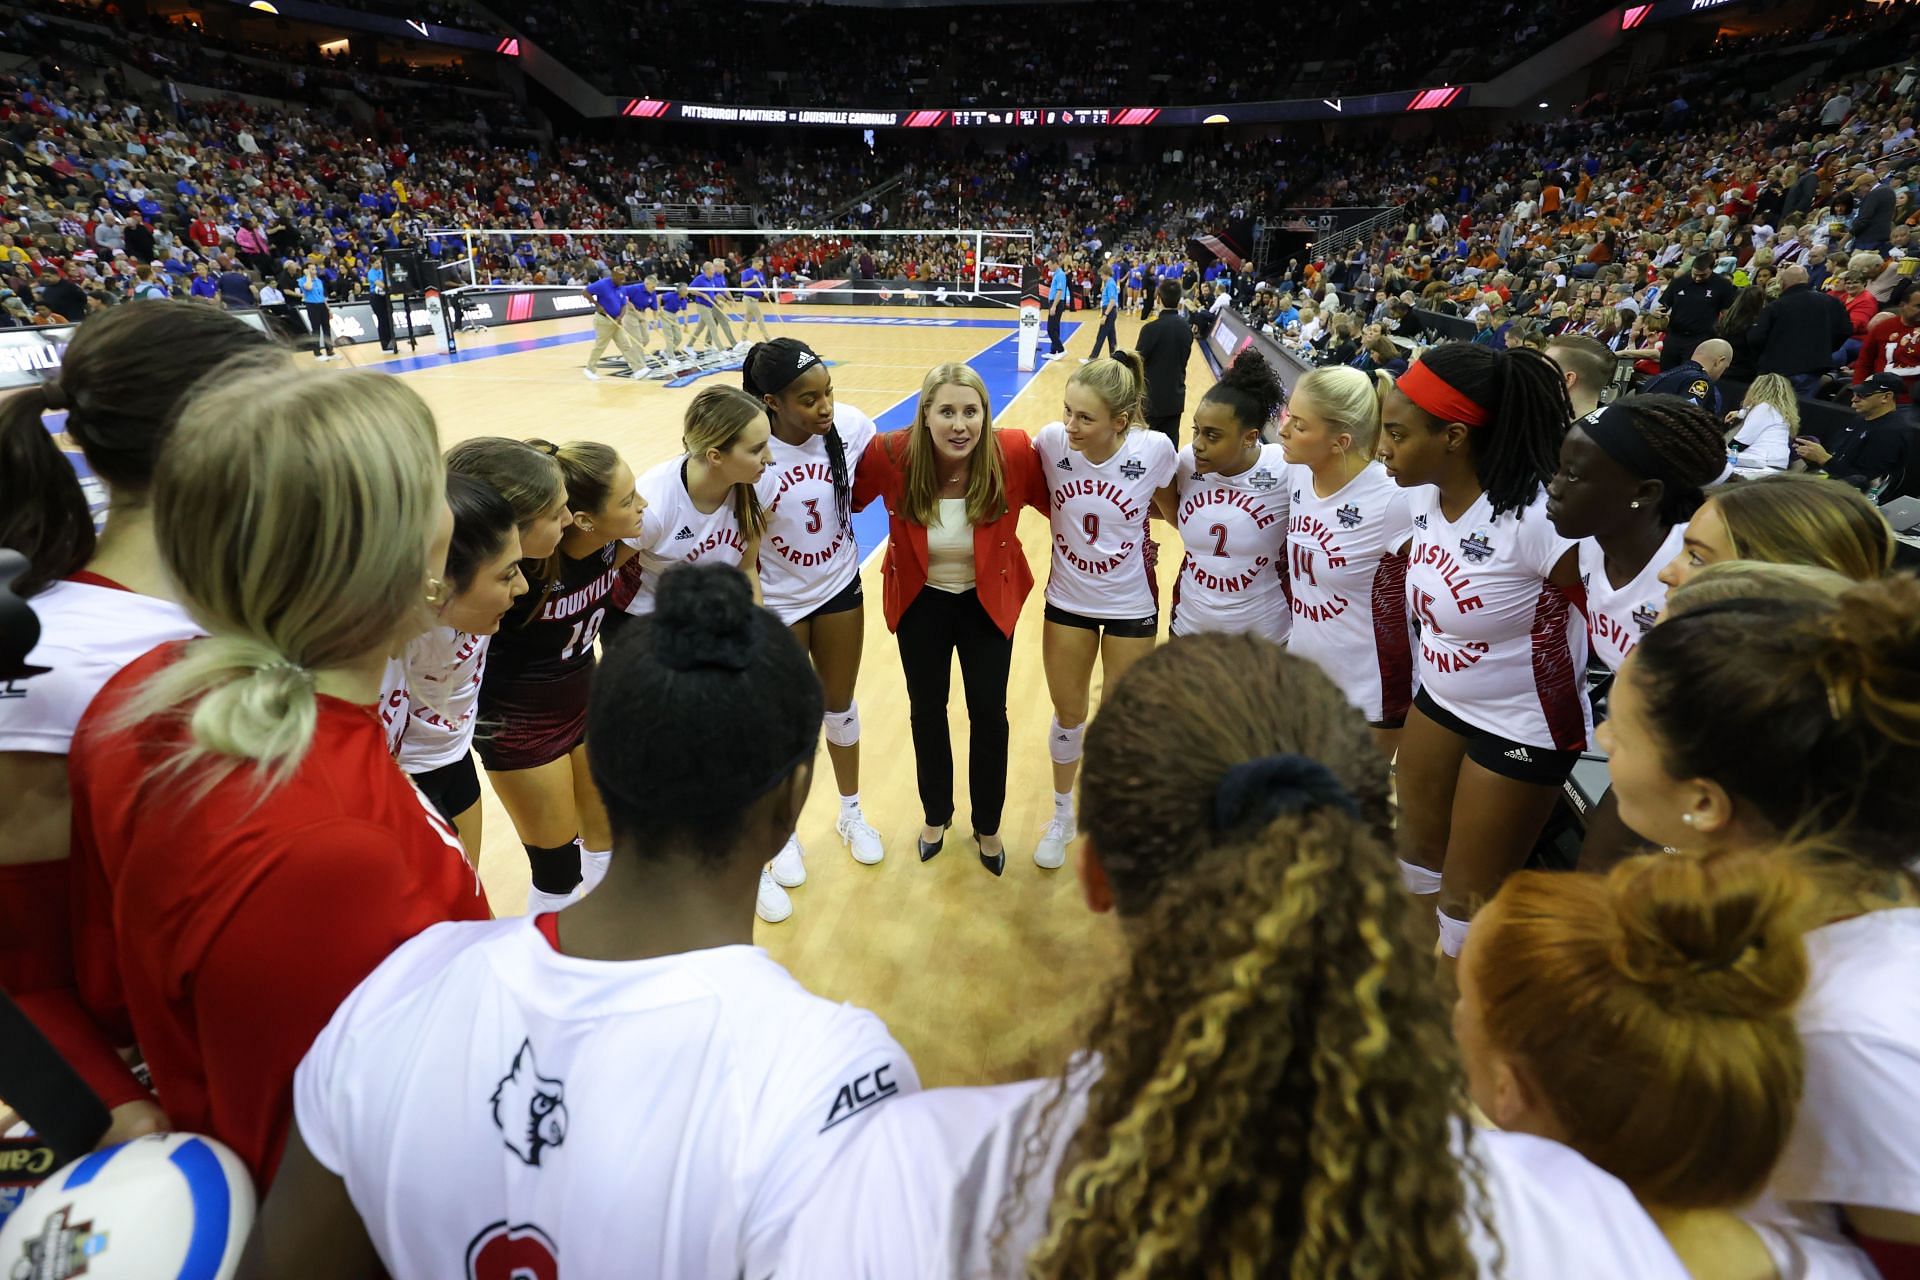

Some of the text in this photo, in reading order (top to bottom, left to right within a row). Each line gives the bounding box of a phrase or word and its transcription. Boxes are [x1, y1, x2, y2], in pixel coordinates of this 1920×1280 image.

[681, 105, 738, 120] PITTSBURGH
[739, 110, 786, 122] PANTHERS
[798, 112, 847, 124] LOUISVILLE
[848, 114, 896, 125] CARDINALS
[1020, 111, 1032, 119] SET
[802, 498, 823, 534] 3
[1053, 479, 1139, 521] LOUISVILLE
[1180, 488, 1275, 530] LOUISVILLE
[1083, 513, 1099, 545] 9
[1209, 523, 1231, 559] 2
[771, 531, 845, 567] CARDINAL
[1056, 533, 1134, 575] CARDINALS
[1293, 543, 1318, 587] 14
[541, 567, 616, 621] LOUISVILL
[562, 607, 606, 661] 10
[1504, 750, 1533, 763] adidas
[1563, 778, 1587, 815] VOLLEYBALL
[825, 1063, 898, 1122] ACC
